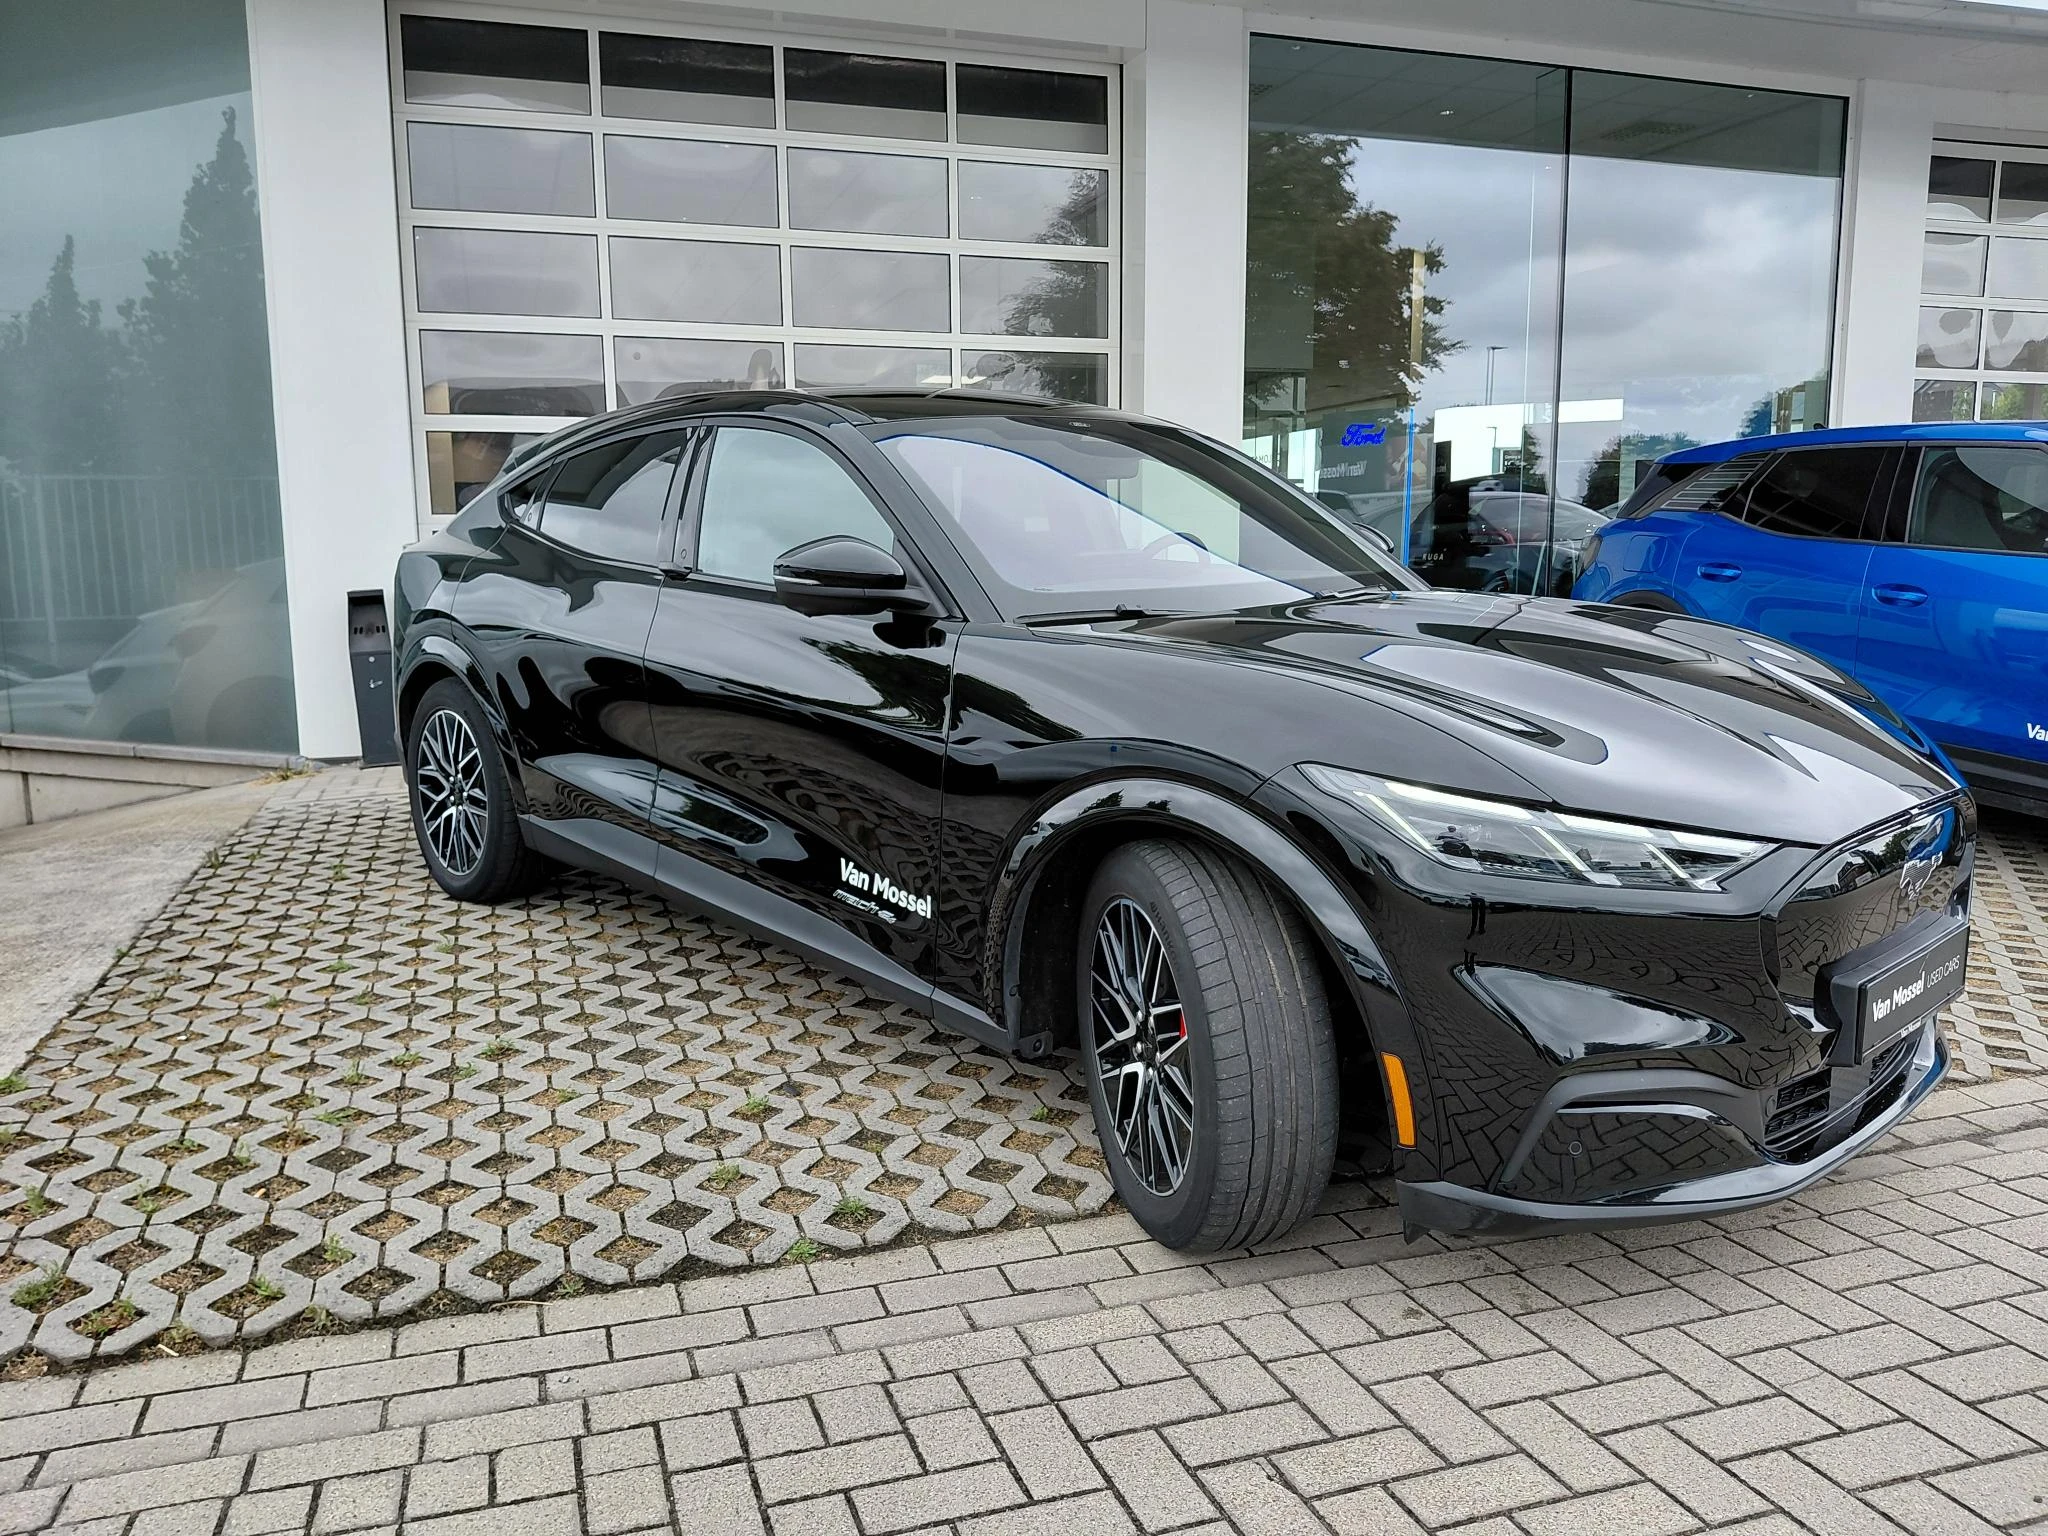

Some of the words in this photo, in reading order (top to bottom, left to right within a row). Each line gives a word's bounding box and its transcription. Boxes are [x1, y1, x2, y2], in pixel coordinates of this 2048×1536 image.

[1341, 423, 1387, 447] Ford
[1422, 553, 1444, 561] KUGA
[841, 857, 870, 891] Van
[872, 872, 932, 919] Mossel
[1873, 998, 1890, 1022] Van
[1892, 971, 1925, 1011] Mossel
[1927, 966, 1943, 988] USED
[1944, 954, 1960, 977] CARS
